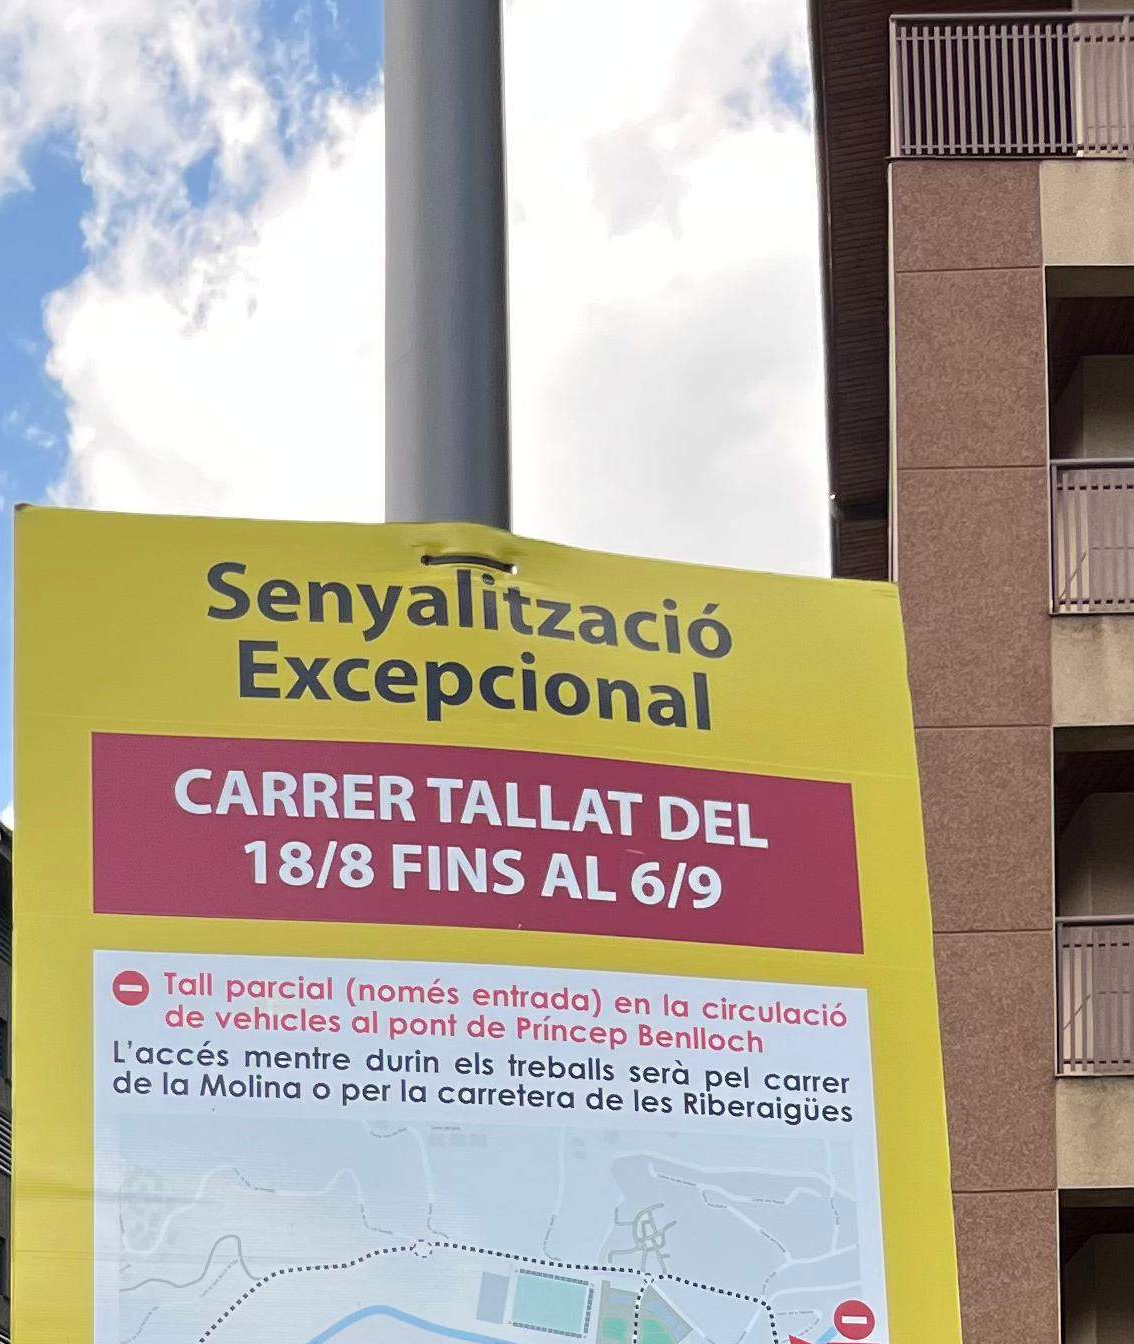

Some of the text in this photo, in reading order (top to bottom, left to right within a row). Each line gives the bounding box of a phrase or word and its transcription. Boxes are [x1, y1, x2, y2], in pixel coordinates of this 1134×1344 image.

[207, 561, 732, 659] Senyalització
[238, 639, 712, 731] Excepcional
[174, 768, 769, 849] CARRER TALLAT DEL
[244, 840, 722, 909] 18/8 FINS AL 6/9
[164, 972, 848, 1027] Tall parcial (només entrada) en la circulació
[165, 1004, 764, 1054] de vehicles al pont de Príncep Benlloch
[113, 1040, 851, 1094] L'accés mentre durin els treballs serà pel carrer
[113, 1070, 853, 1126] de la Molina o per la carretera de les Riberaigües
